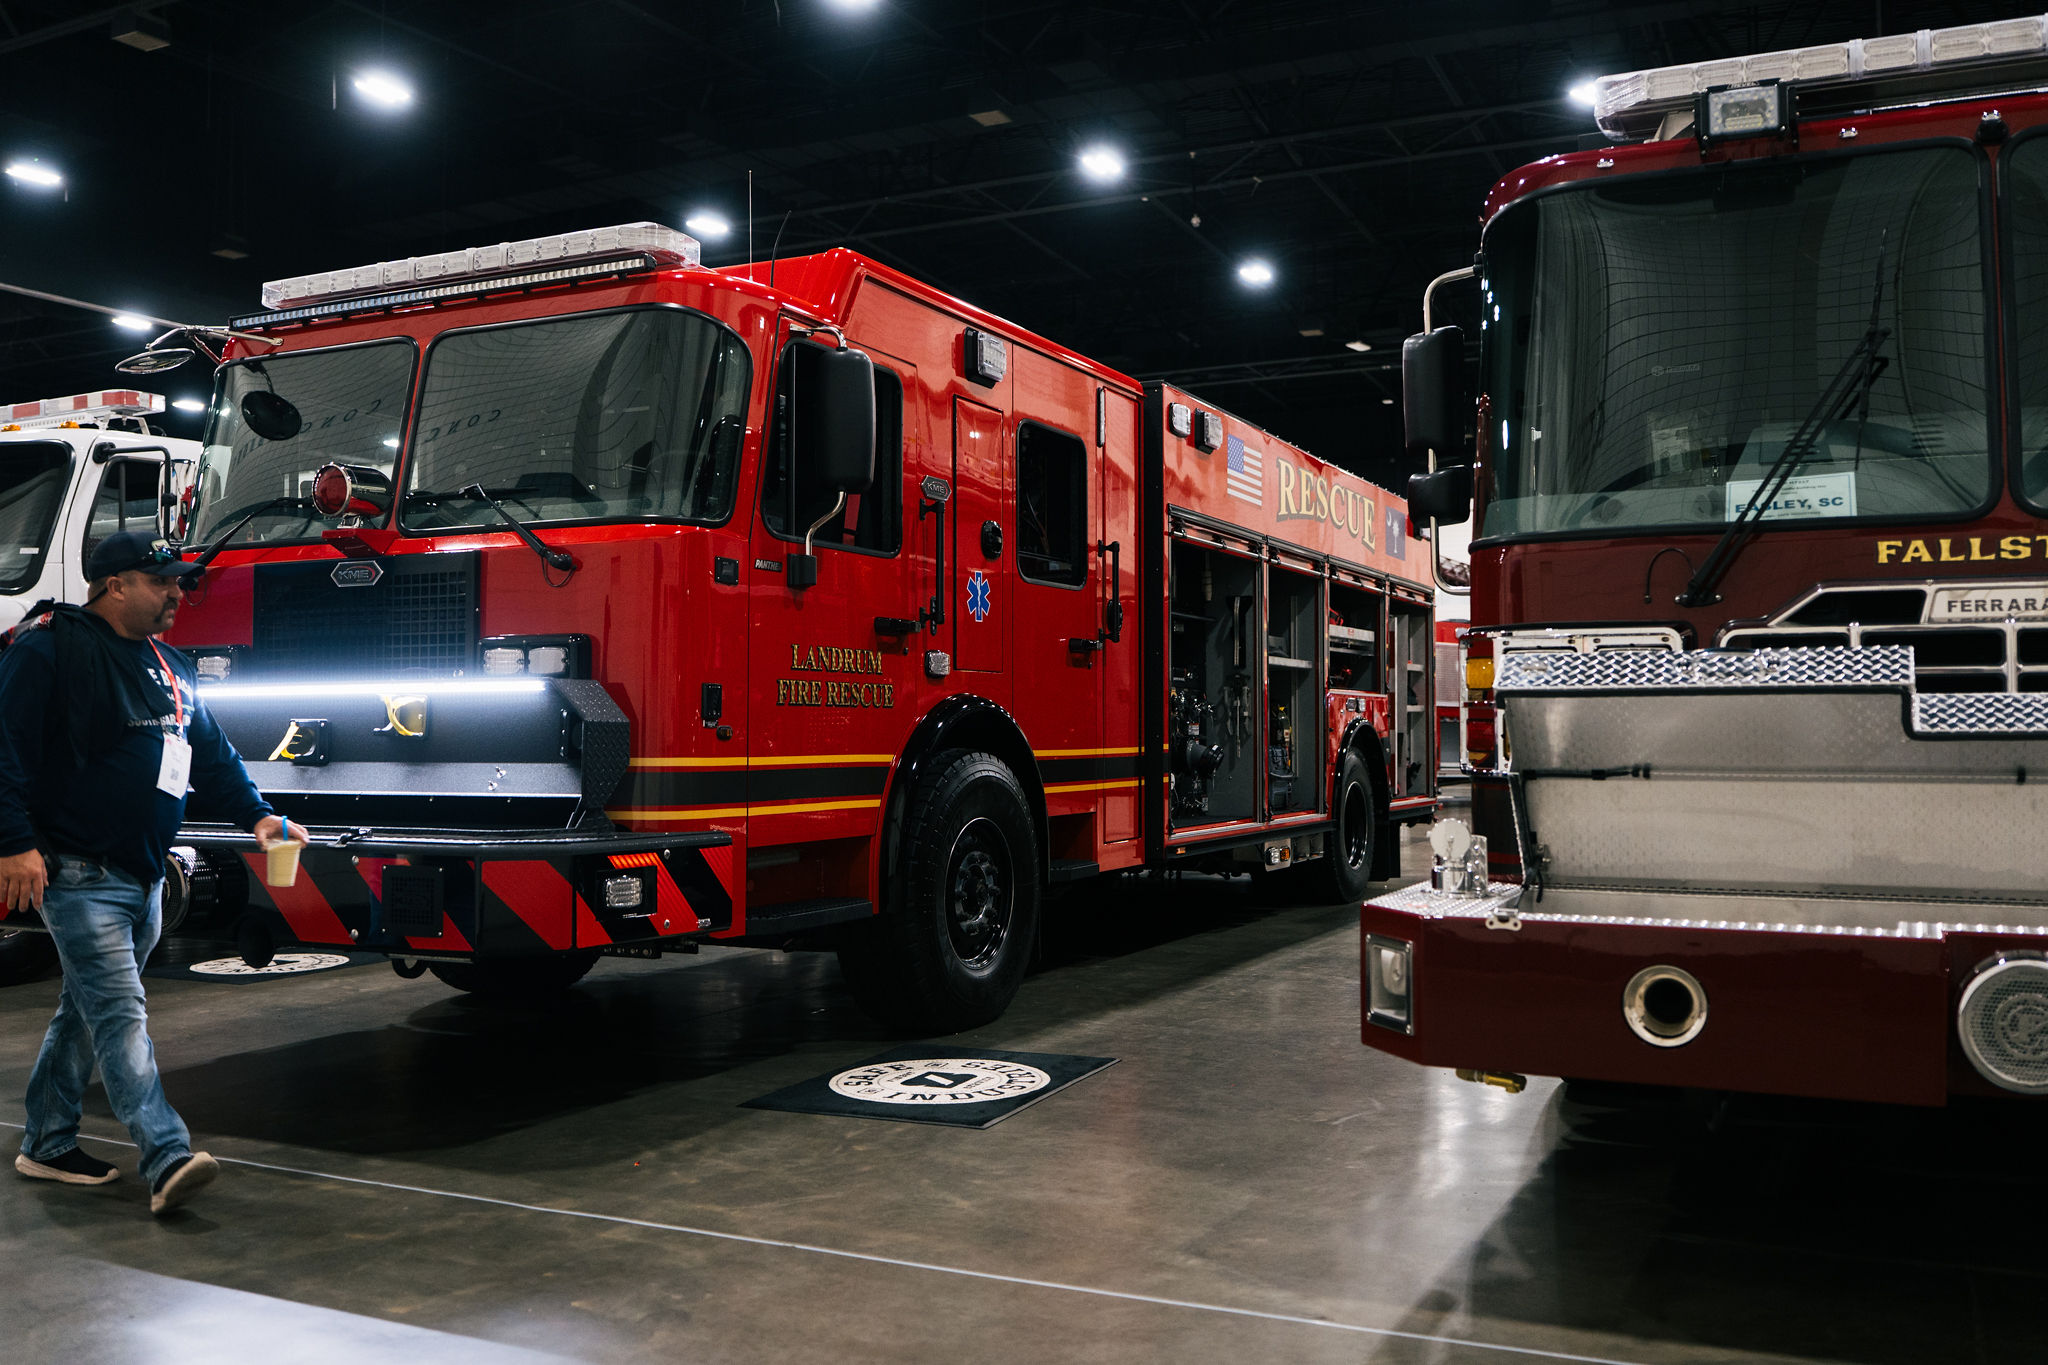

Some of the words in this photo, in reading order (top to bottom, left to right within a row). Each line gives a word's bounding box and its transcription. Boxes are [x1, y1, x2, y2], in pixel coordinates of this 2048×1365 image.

[926, 482, 945, 495] KME
[1818, 497, 1844, 507] SC
[1276, 456, 1375, 555] RESCUE
[338, 570, 369, 581] KME
[791, 644, 882, 675] LANDRUM
[776, 679, 822, 706] FIRE
[826, 681, 894, 708] RESCUE
[843, 1063, 914, 1086] SAFE
[883, 1061, 1036, 1101] INDUSTRIES
